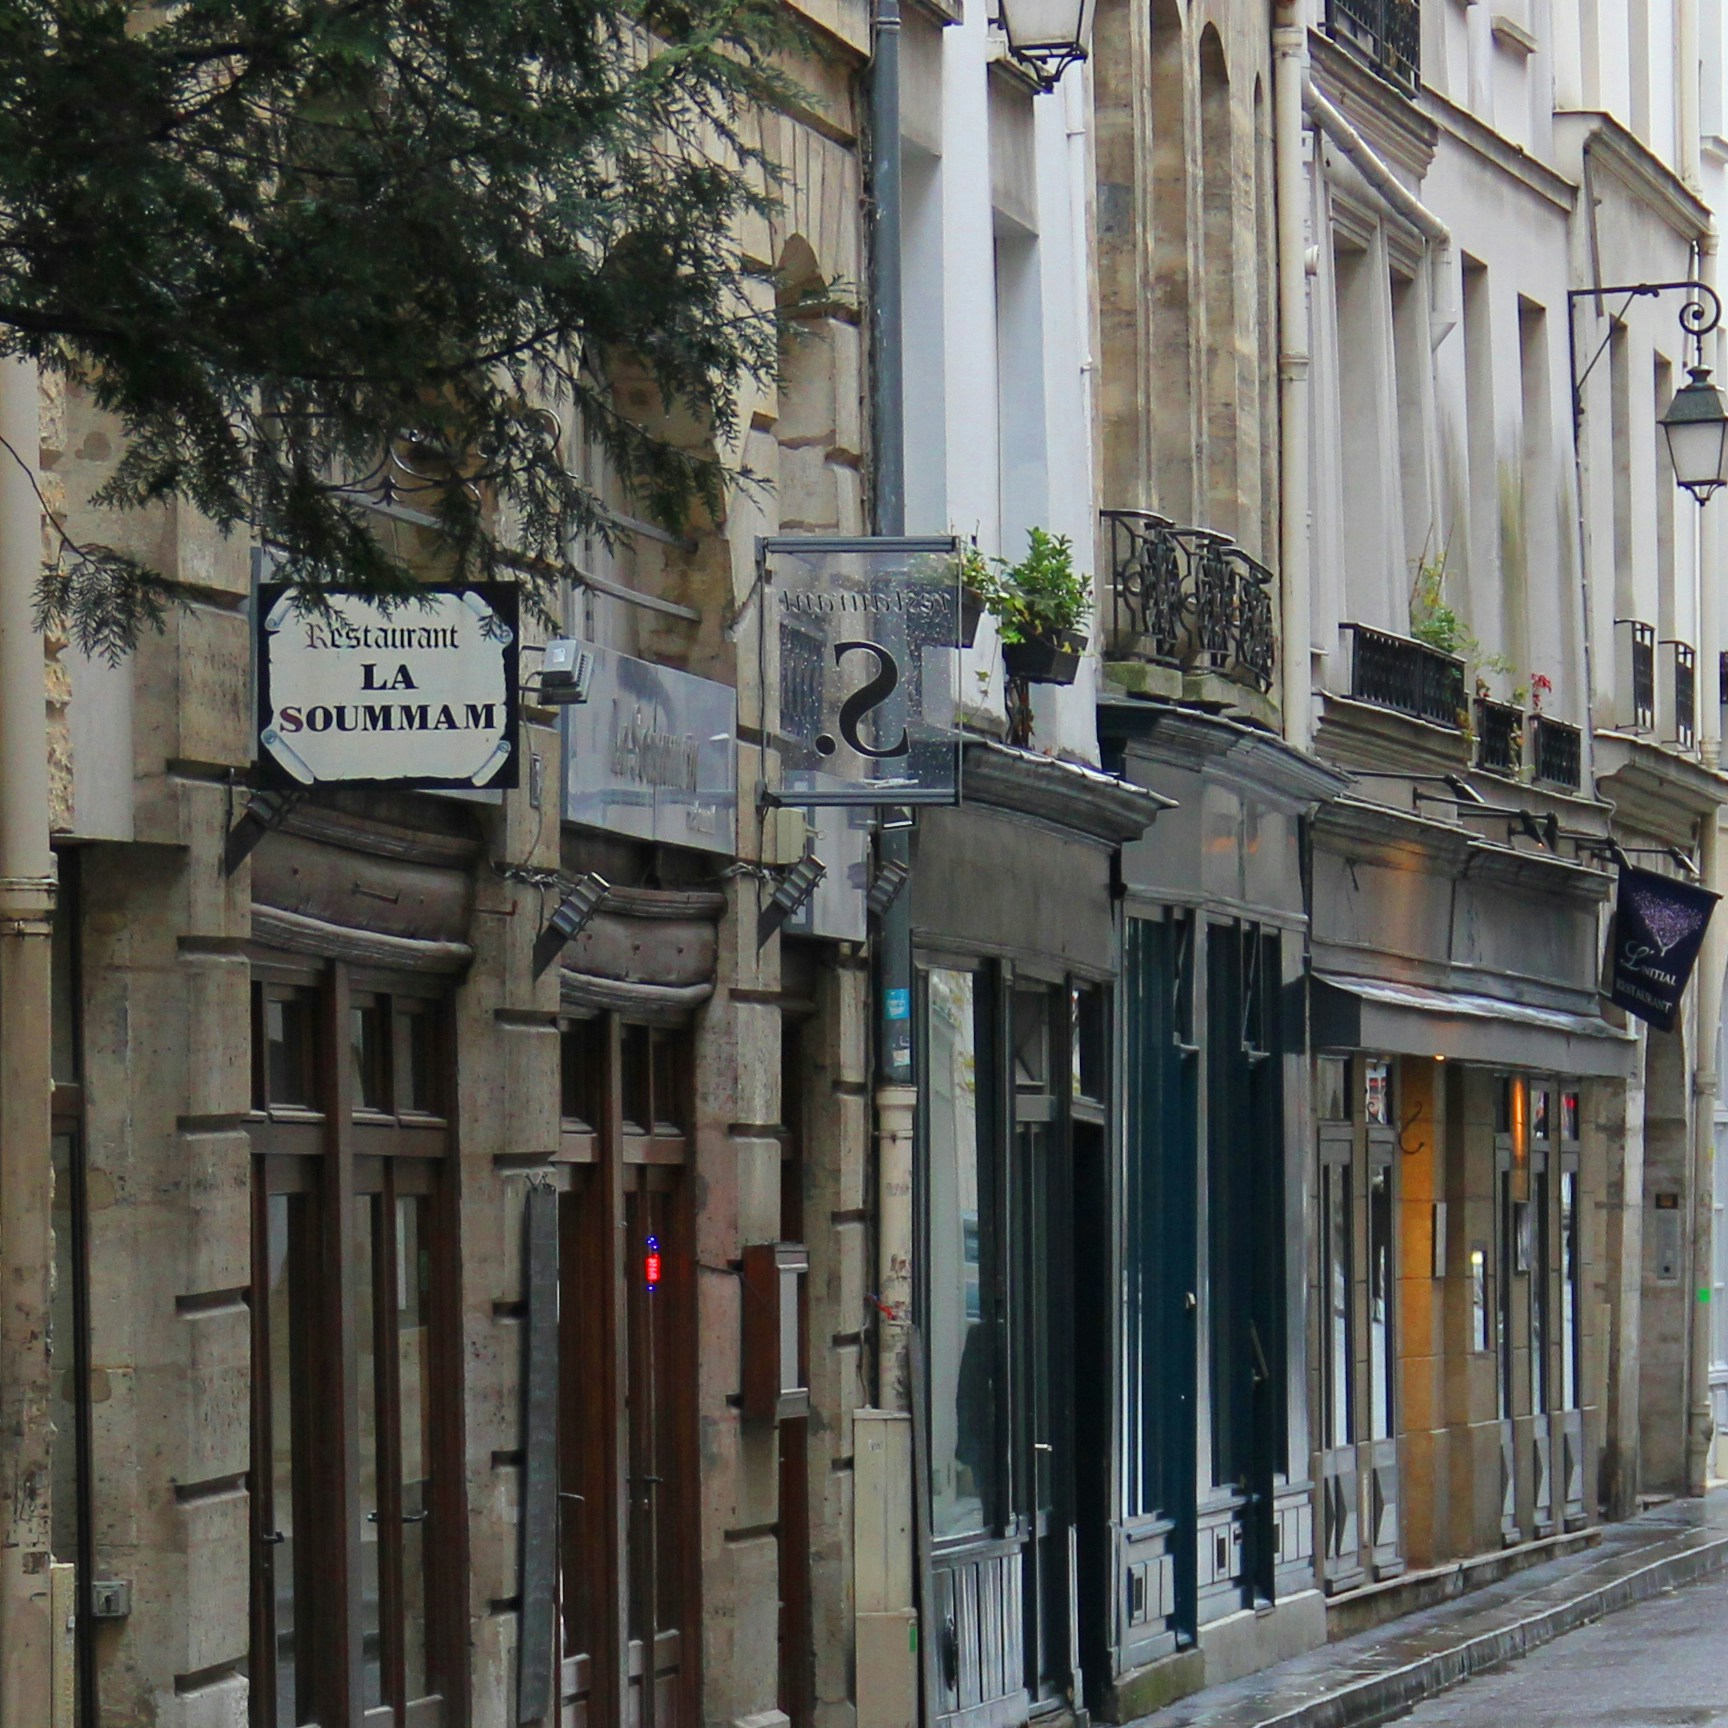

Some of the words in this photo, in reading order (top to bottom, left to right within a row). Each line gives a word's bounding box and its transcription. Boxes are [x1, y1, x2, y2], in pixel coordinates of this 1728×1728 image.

[305, 622, 460, 650] Restaurant
[360, 662, 420, 691] LA
[279, 703, 497, 733] SOUMMAM
